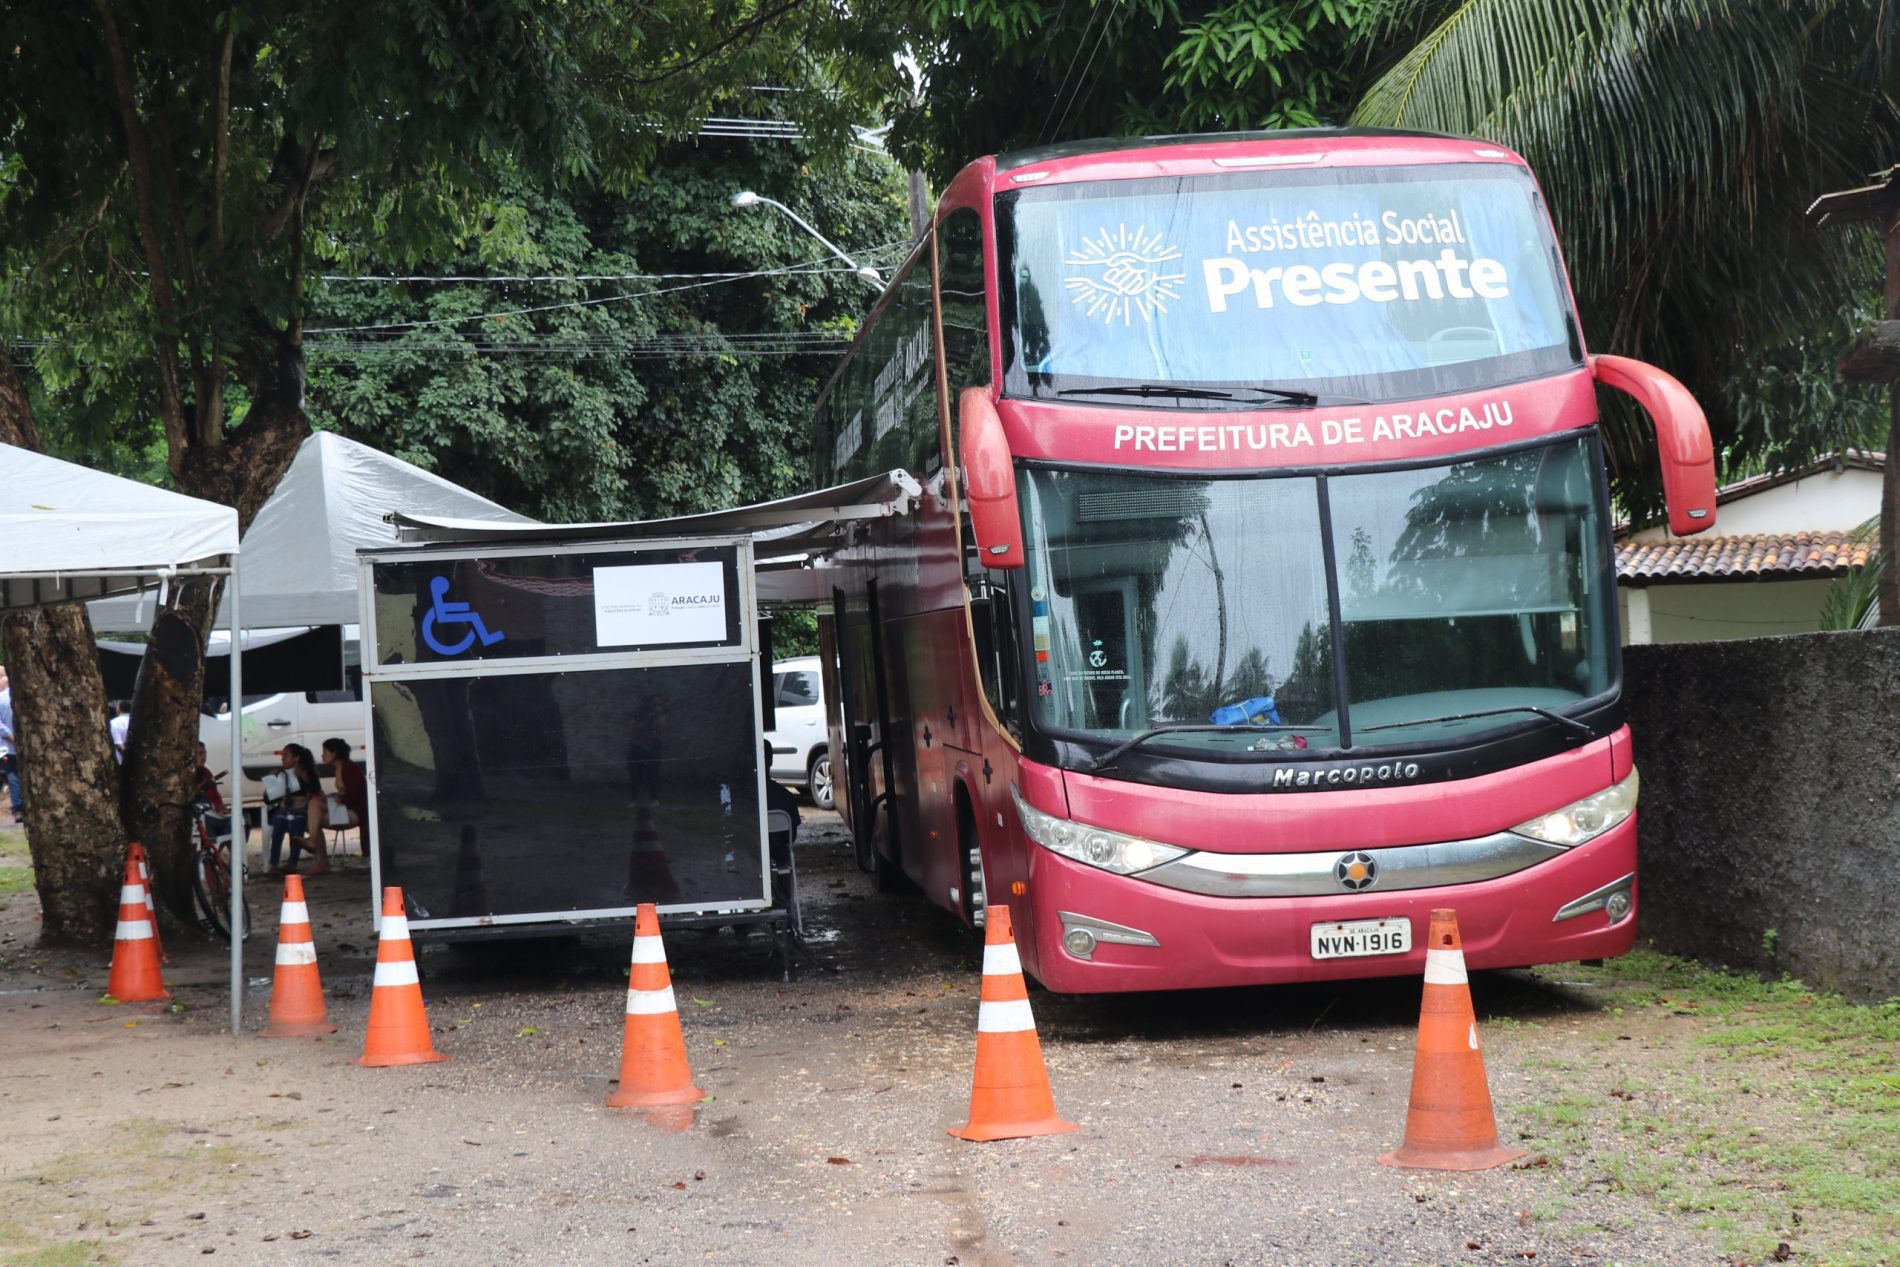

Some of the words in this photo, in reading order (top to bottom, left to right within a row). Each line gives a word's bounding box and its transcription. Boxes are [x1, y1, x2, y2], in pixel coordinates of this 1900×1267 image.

[1227, 210, 1380, 254] Assistência
[1382, 208, 1466, 245] Social
[1202, 248, 1510, 313] Presente
[1114, 422, 1315, 451] PREFEITURA
[1321, 418, 1364, 446] DE
[1372, 400, 1514, 442] ARACAJU
[671, 595, 720, 605] ARACAJU
[1273, 762, 1419, 788] Marcopolo
